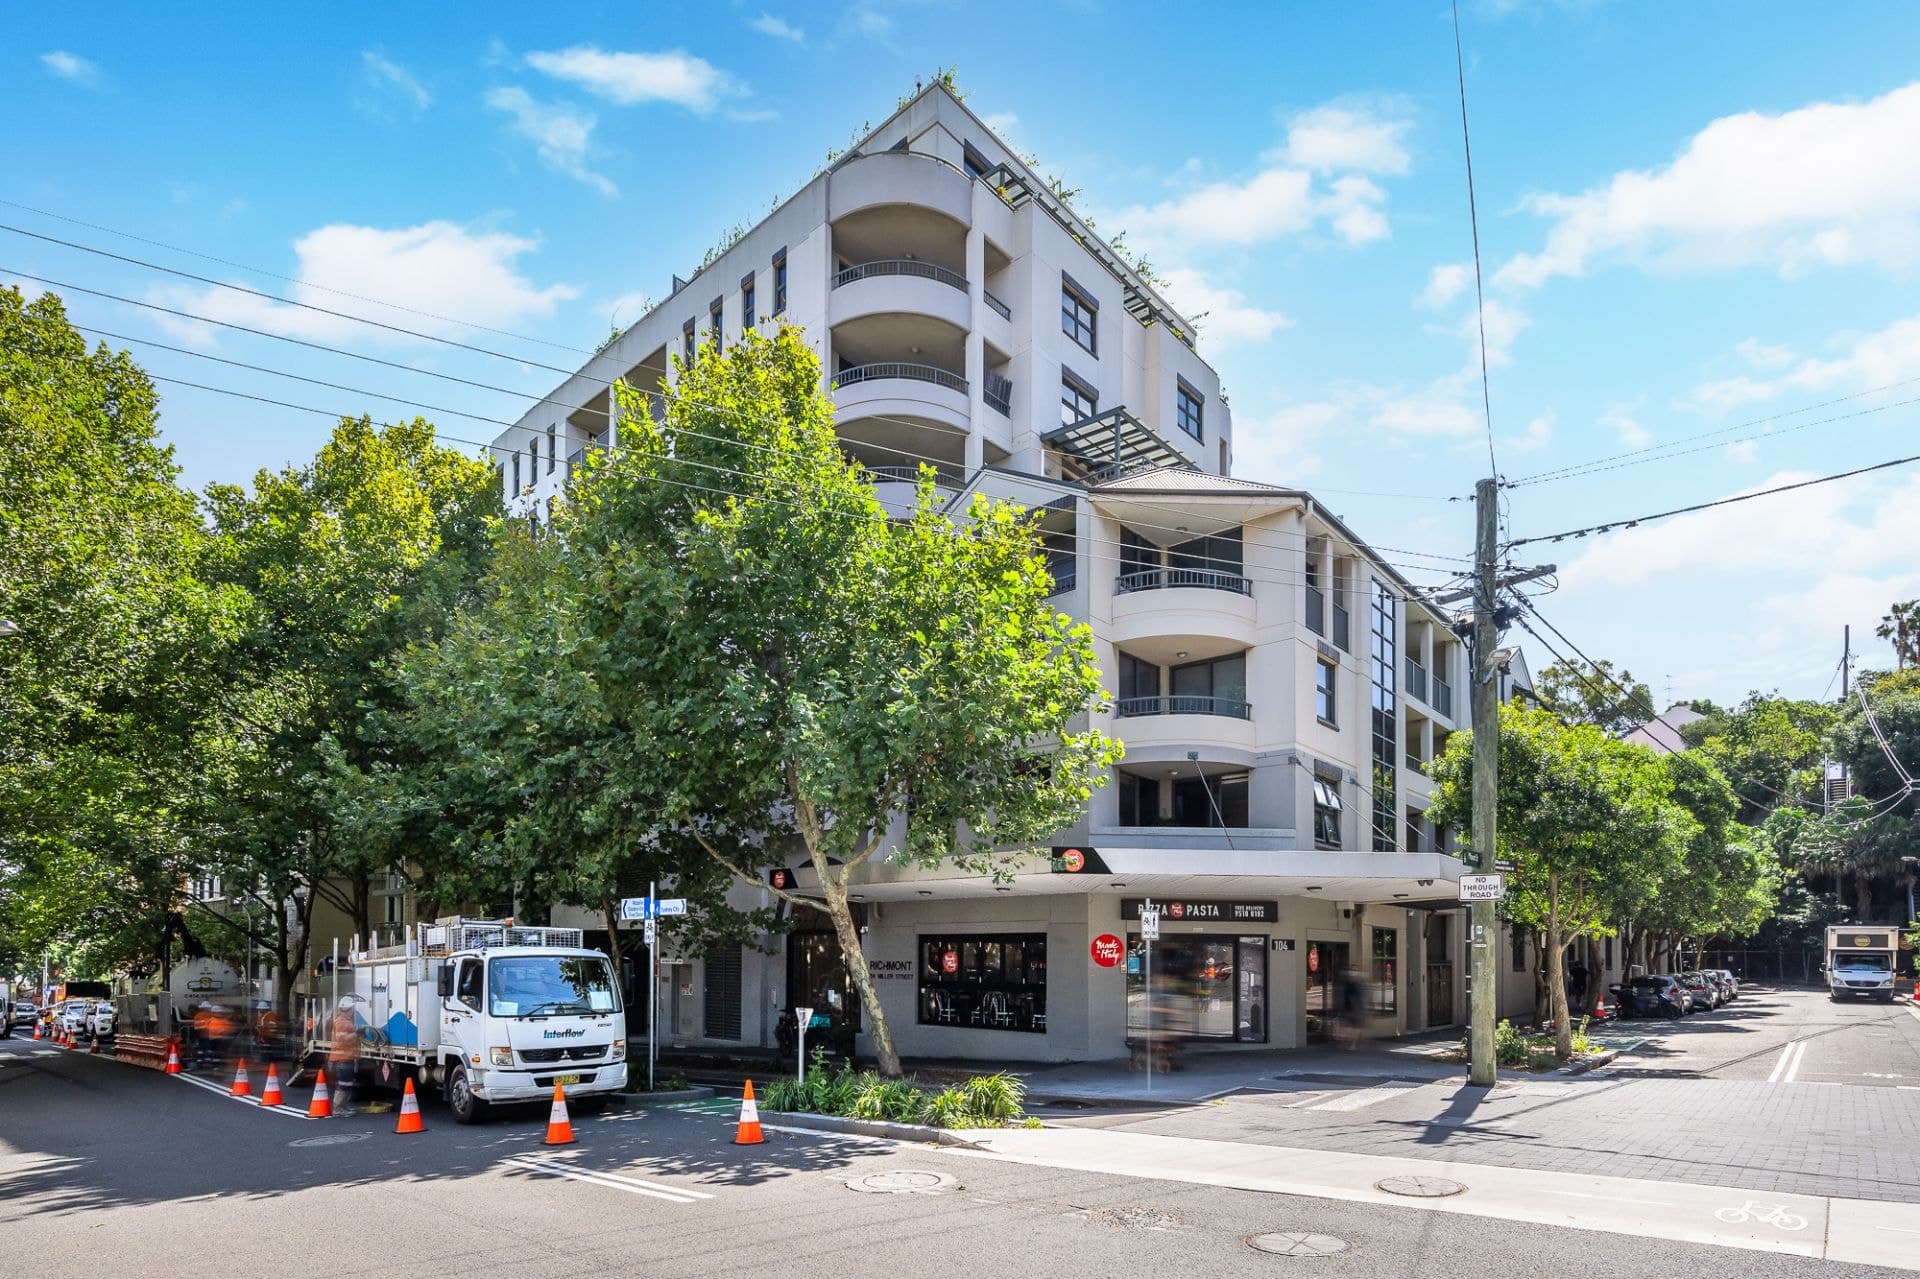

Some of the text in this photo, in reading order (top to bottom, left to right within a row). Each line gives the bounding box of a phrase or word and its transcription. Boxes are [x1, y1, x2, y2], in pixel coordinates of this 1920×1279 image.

[1137, 904, 1168, 916] PZZA
[1186, 904, 1219, 916] PASTA
[1096, 940, 1119, 949] Made
[1101, 948, 1120, 964] Italy
[870, 960, 913, 970] RICHMONT
[543, 1028, 586, 1039] Interflow
